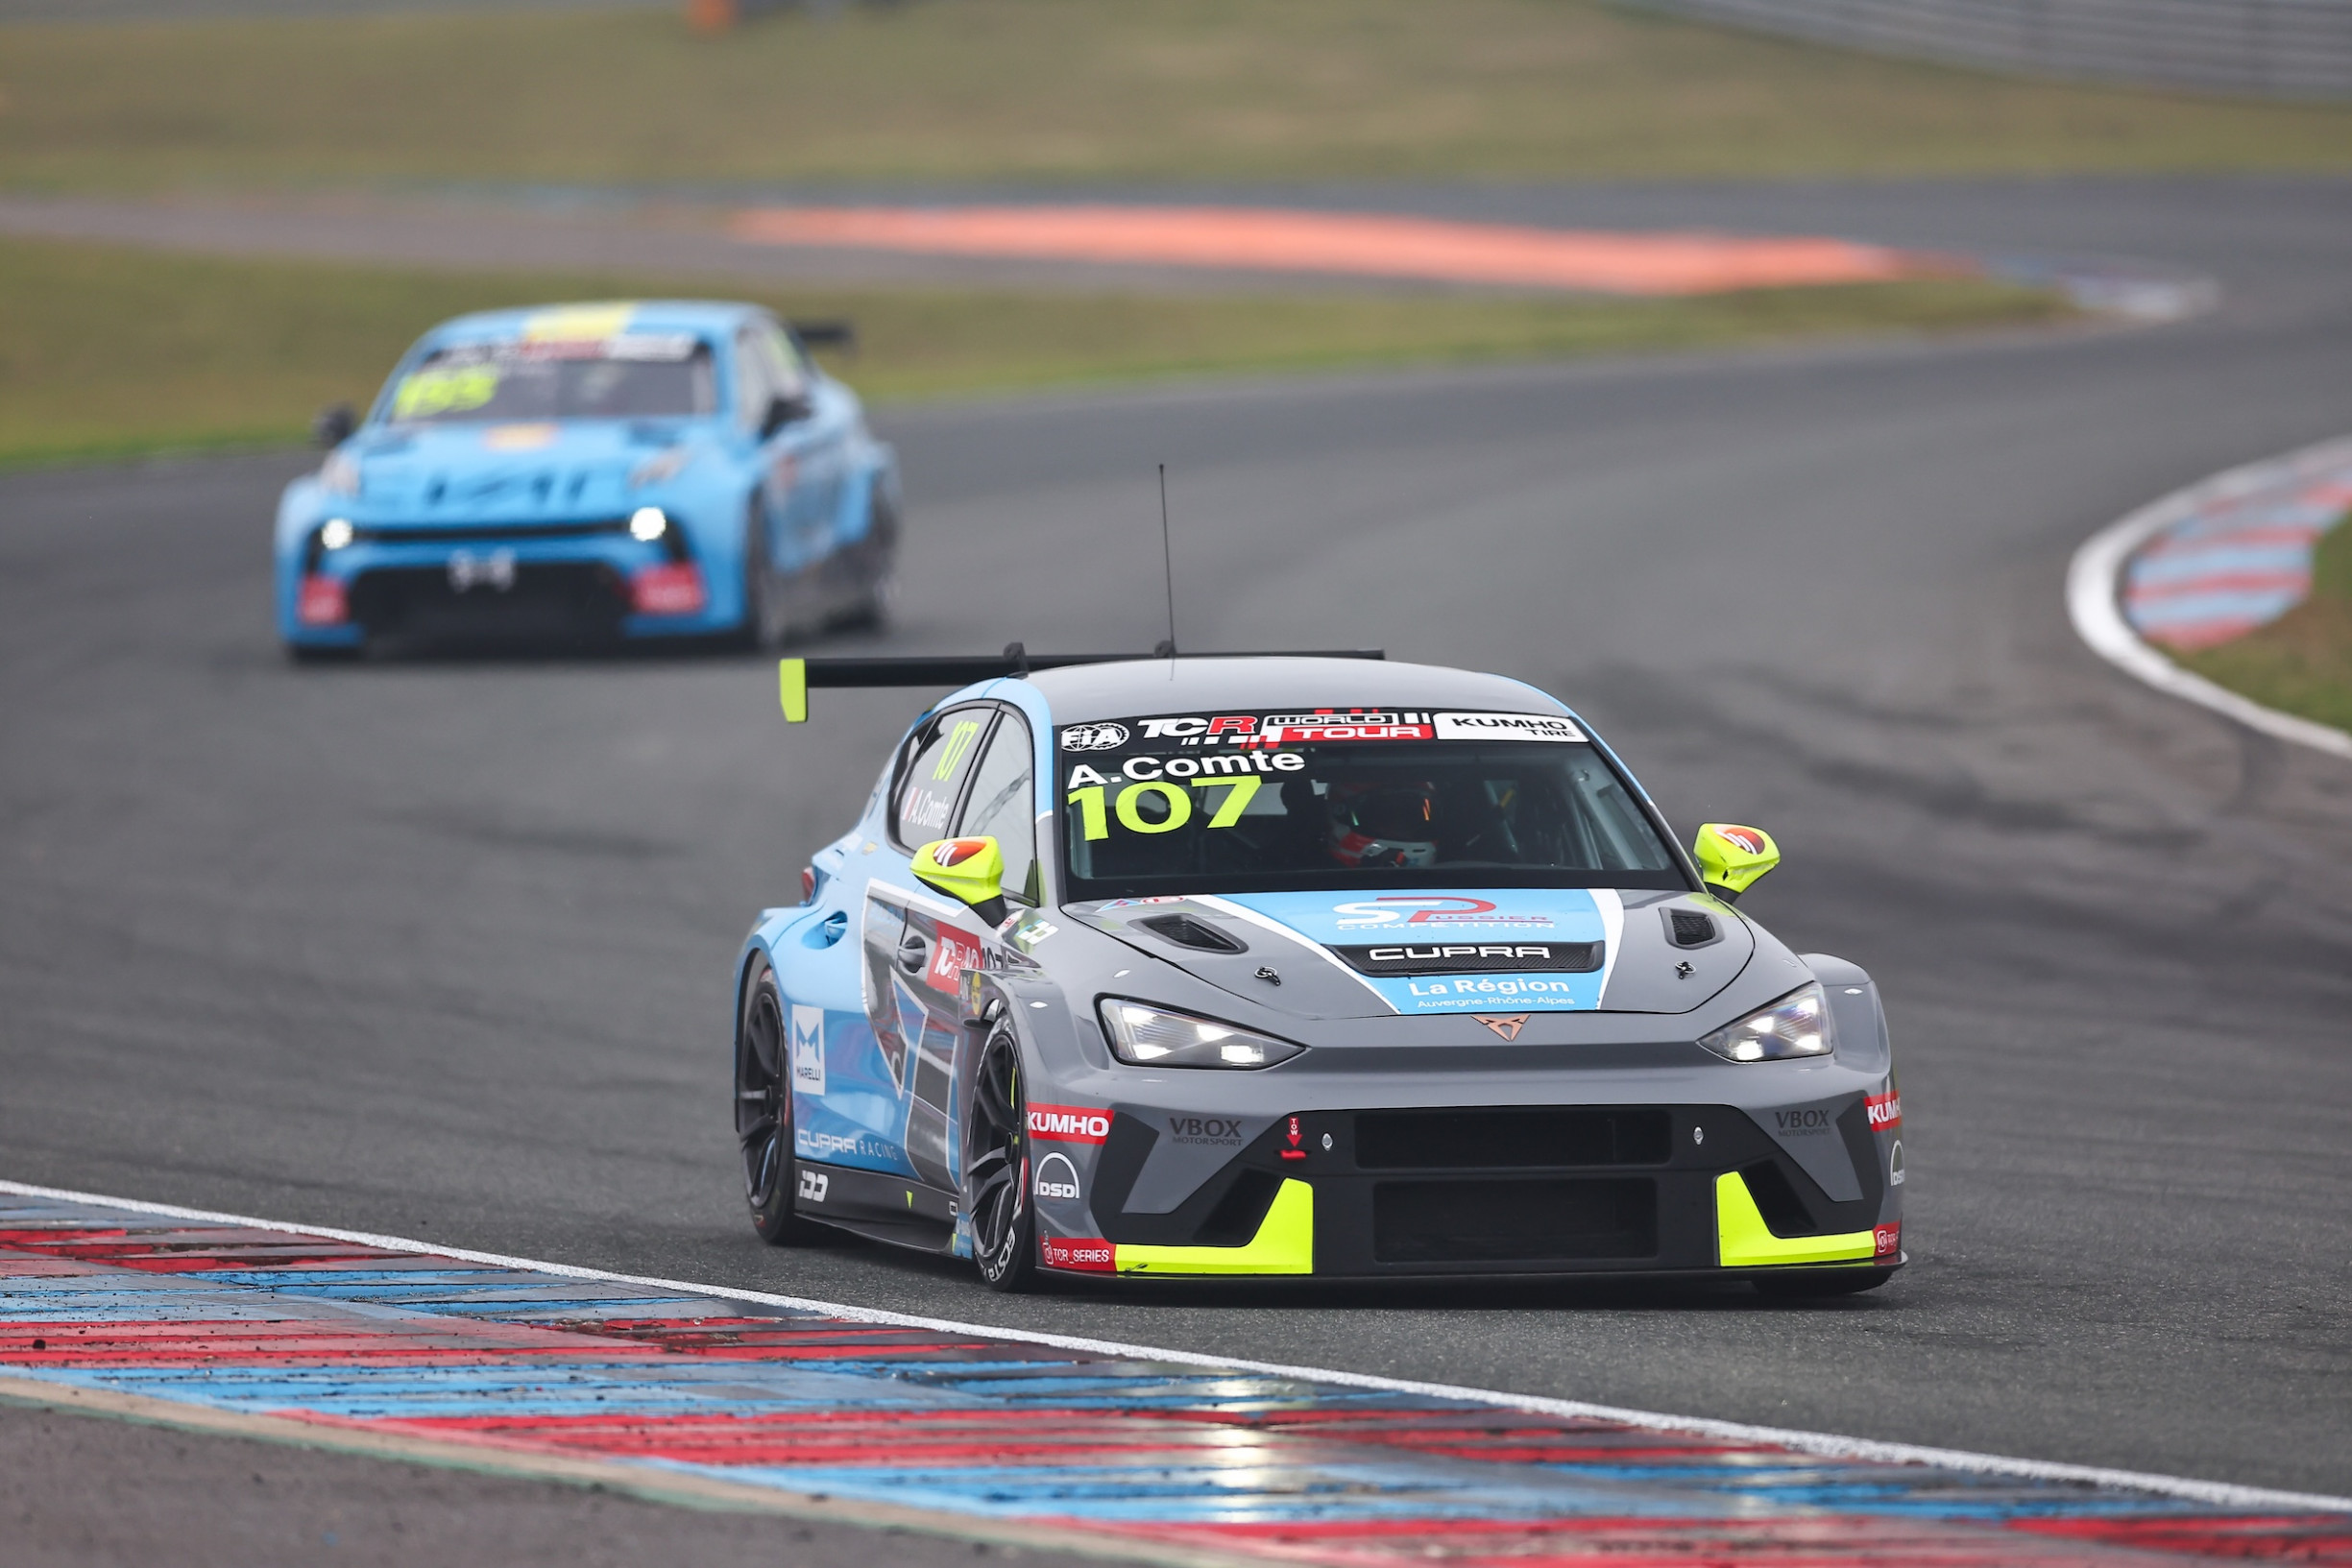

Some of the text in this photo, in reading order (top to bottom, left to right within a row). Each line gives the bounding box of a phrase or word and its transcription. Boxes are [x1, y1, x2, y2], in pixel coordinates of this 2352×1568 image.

[1137, 716, 1257, 738] TCR
[1273, 715, 1386, 725] WORLD
[1452, 717, 1567, 730] KUMHO
[1293, 727, 1421, 739] TOUR
[1525, 728, 1576, 738] TIRE
[1066, 749, 1305, 789] A.Comte
[1068, 775, 1263, 842] 107
[1338, 922, 1555, 931] COMPETITION
[1369, 946, 1551, 961] CUPRA
[1409, 977, 1570, 997] La Région
[1418, 996, 1575, 1008] Auvergne-Rhône-Alpes
[796, 1066, 820, 1081] MARELLI
[1775, 1110, 1829, 1128] VBOX
[1867, 1098, 1902, 1124] KUM
[1027, 1111, 1109, 1137] KUMHO
[1170, 1117, 1242, 1138] VBOX
[1290, 1118, 1298, 1135] TOW
[798, 1128, 898, 1161] CUPRA RACING
[1173, 1136, 1244, 1146] MOTORSPORT
[1040, 1181, 1076, 1198] DSD
[1054, 1248, 1110, 1265] TCR_SERIES
